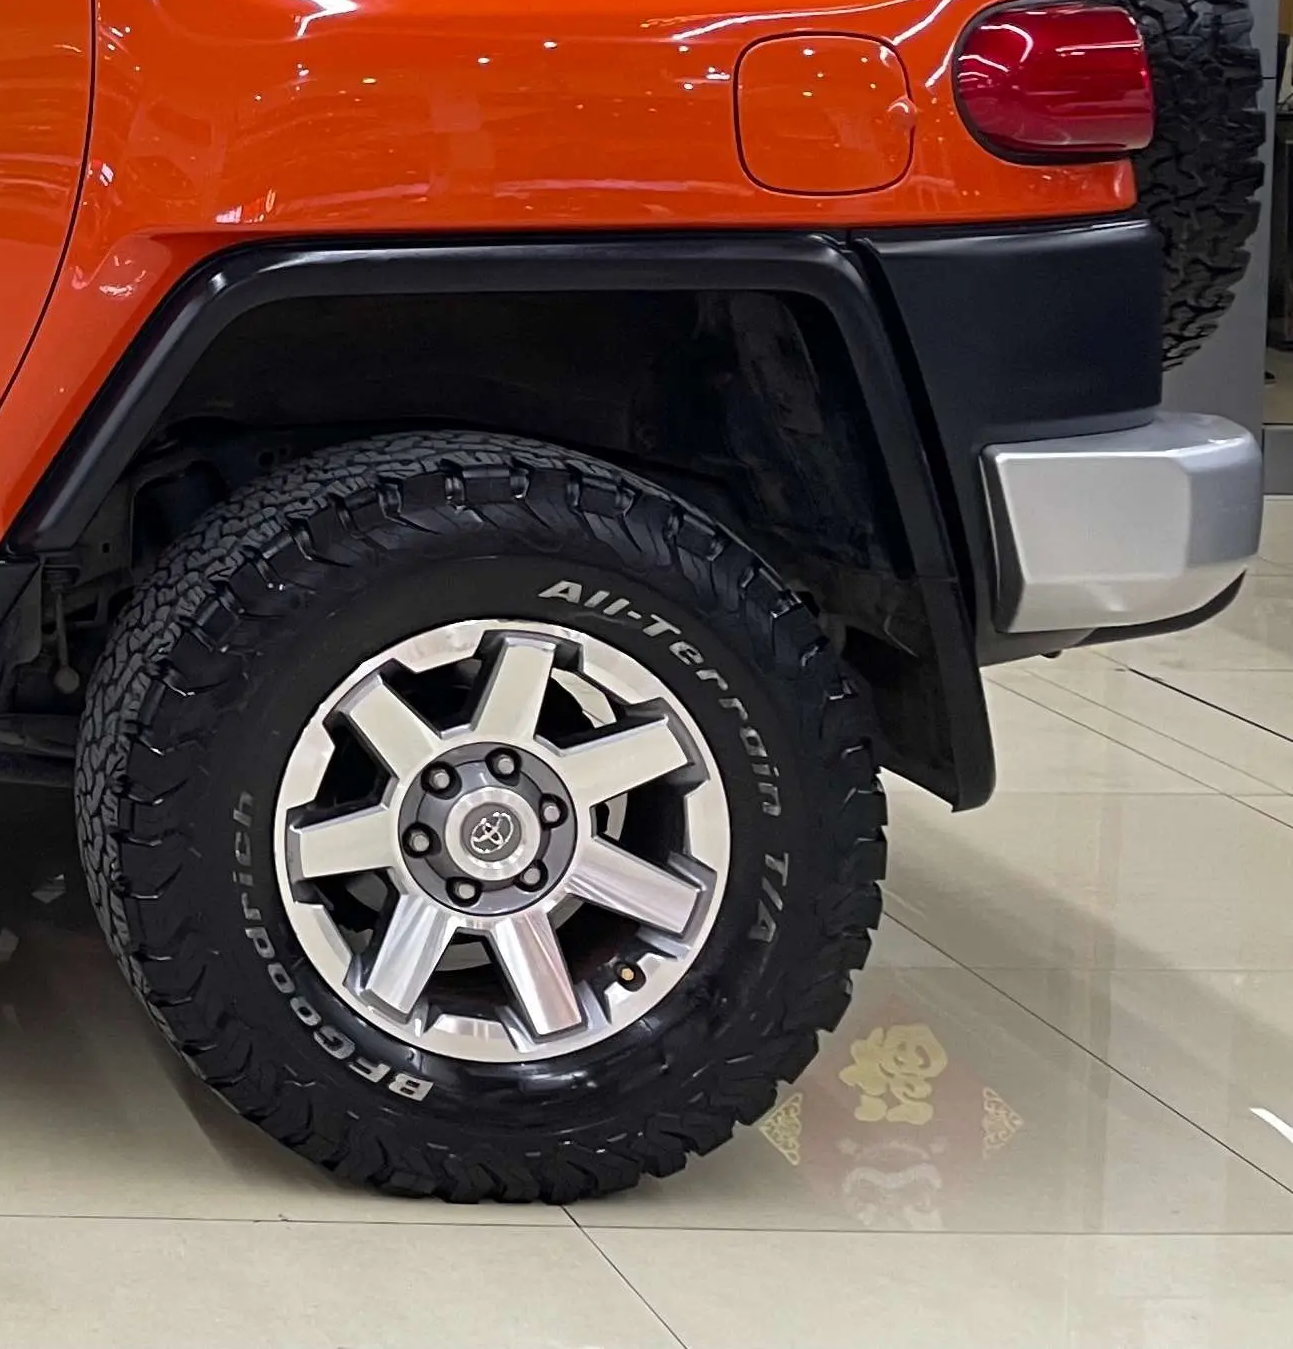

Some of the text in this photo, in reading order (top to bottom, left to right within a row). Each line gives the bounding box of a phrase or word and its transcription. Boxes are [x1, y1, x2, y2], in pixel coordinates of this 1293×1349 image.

[538, 579, 789, 943] All-Terrain T/A
[232, 790, 435, 1101] BFGoodrich
